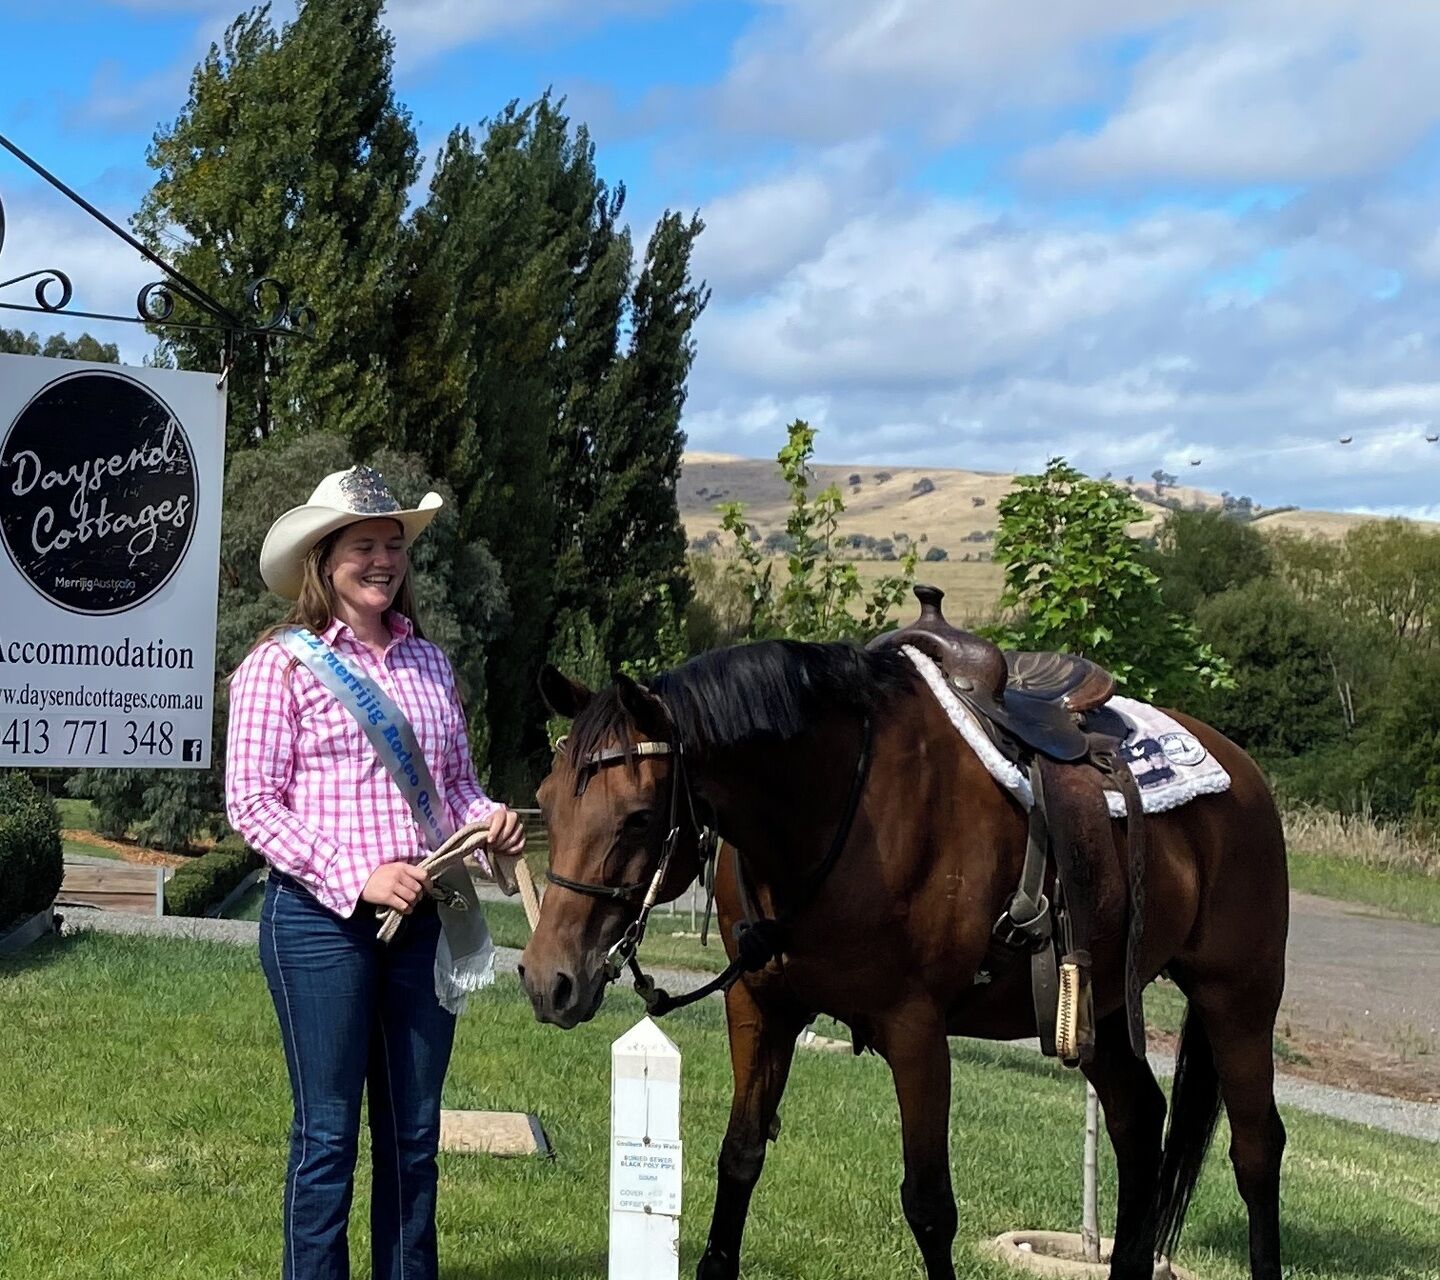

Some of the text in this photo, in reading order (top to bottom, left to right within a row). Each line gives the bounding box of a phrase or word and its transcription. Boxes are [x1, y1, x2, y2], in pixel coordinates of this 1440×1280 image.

[11, 417, 177, 519] Daysend
[31, 494, 191, 568] Cottages
[64, 720, 109, 755] 771
[123, 720, 174, 756] 348
[323, 648, 387, 726] Merrijig
[381, 724, 420, 787] Rodeo
[417, 790, 444, 841] Quee
